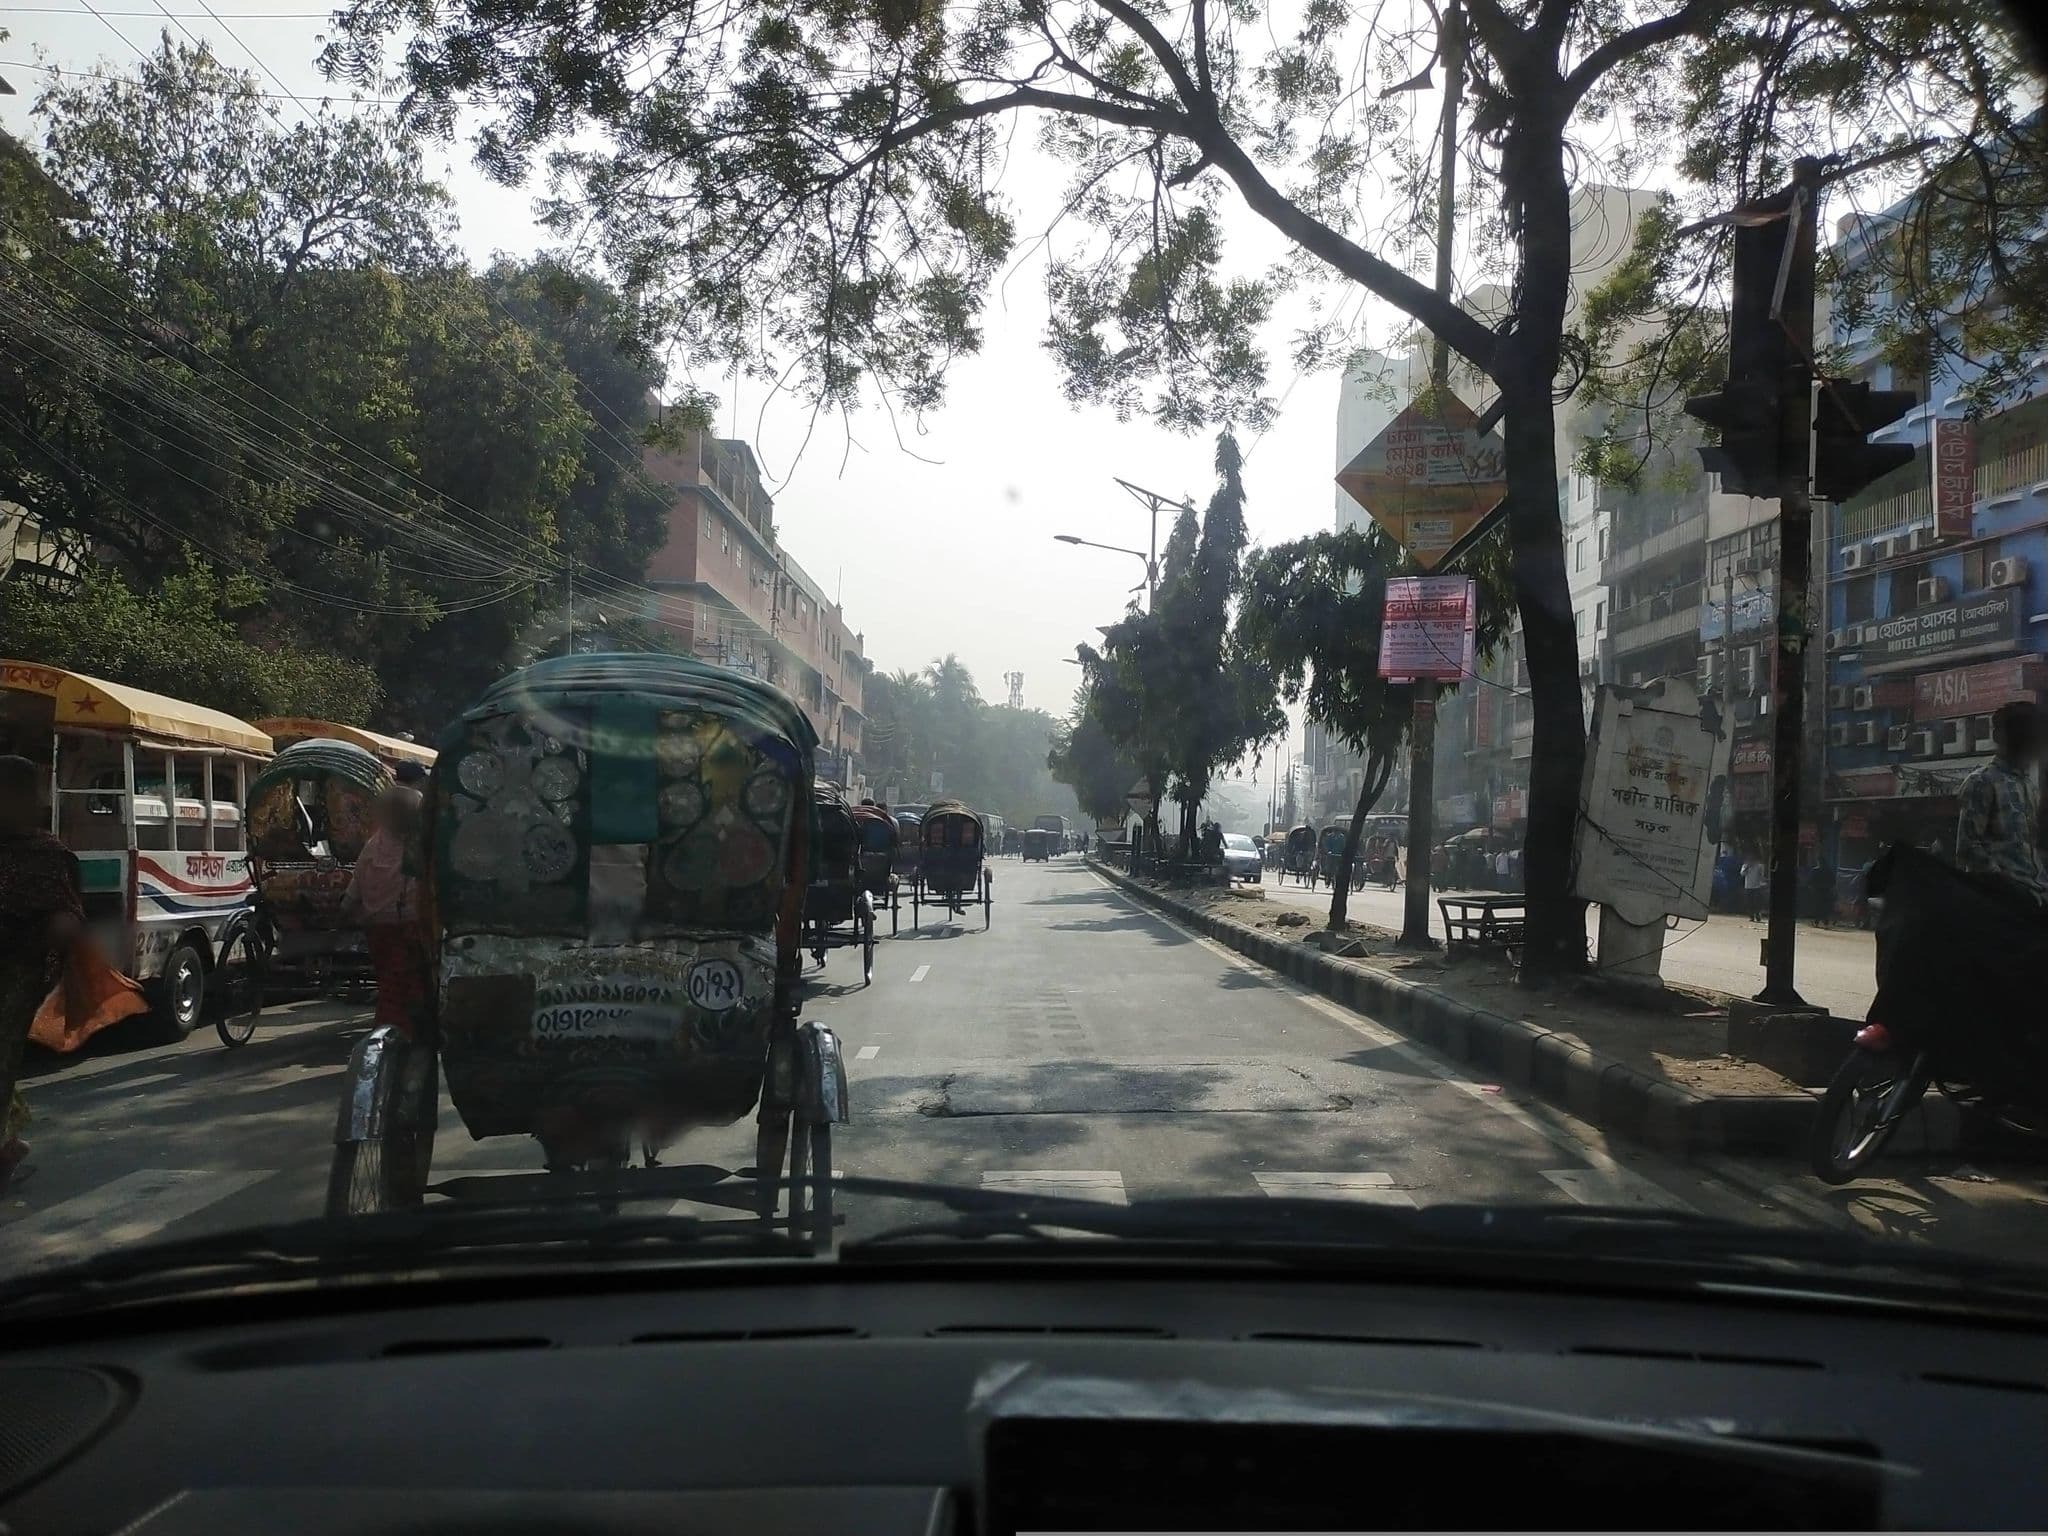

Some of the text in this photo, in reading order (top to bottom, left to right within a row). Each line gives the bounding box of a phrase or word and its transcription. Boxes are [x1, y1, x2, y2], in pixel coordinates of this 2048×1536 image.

[1387, 431, 1421, 444] ঢাকা
[1386, 444, 1427, 461] মেয়র
[1879, 598, 2009, 639] হোটেল আসর (আবাসিক)
[1887, 636, 1917, 653] HOTEL
[1919, 629, 1956, 647] ASHOR
[1933, 671, 1969, 707] ASIA
[1612, 786, 1650, 808] শহীদ
[1635, 819, 1672, 834] সড়ক
[186, 852, 225, 880] ফাইজা
